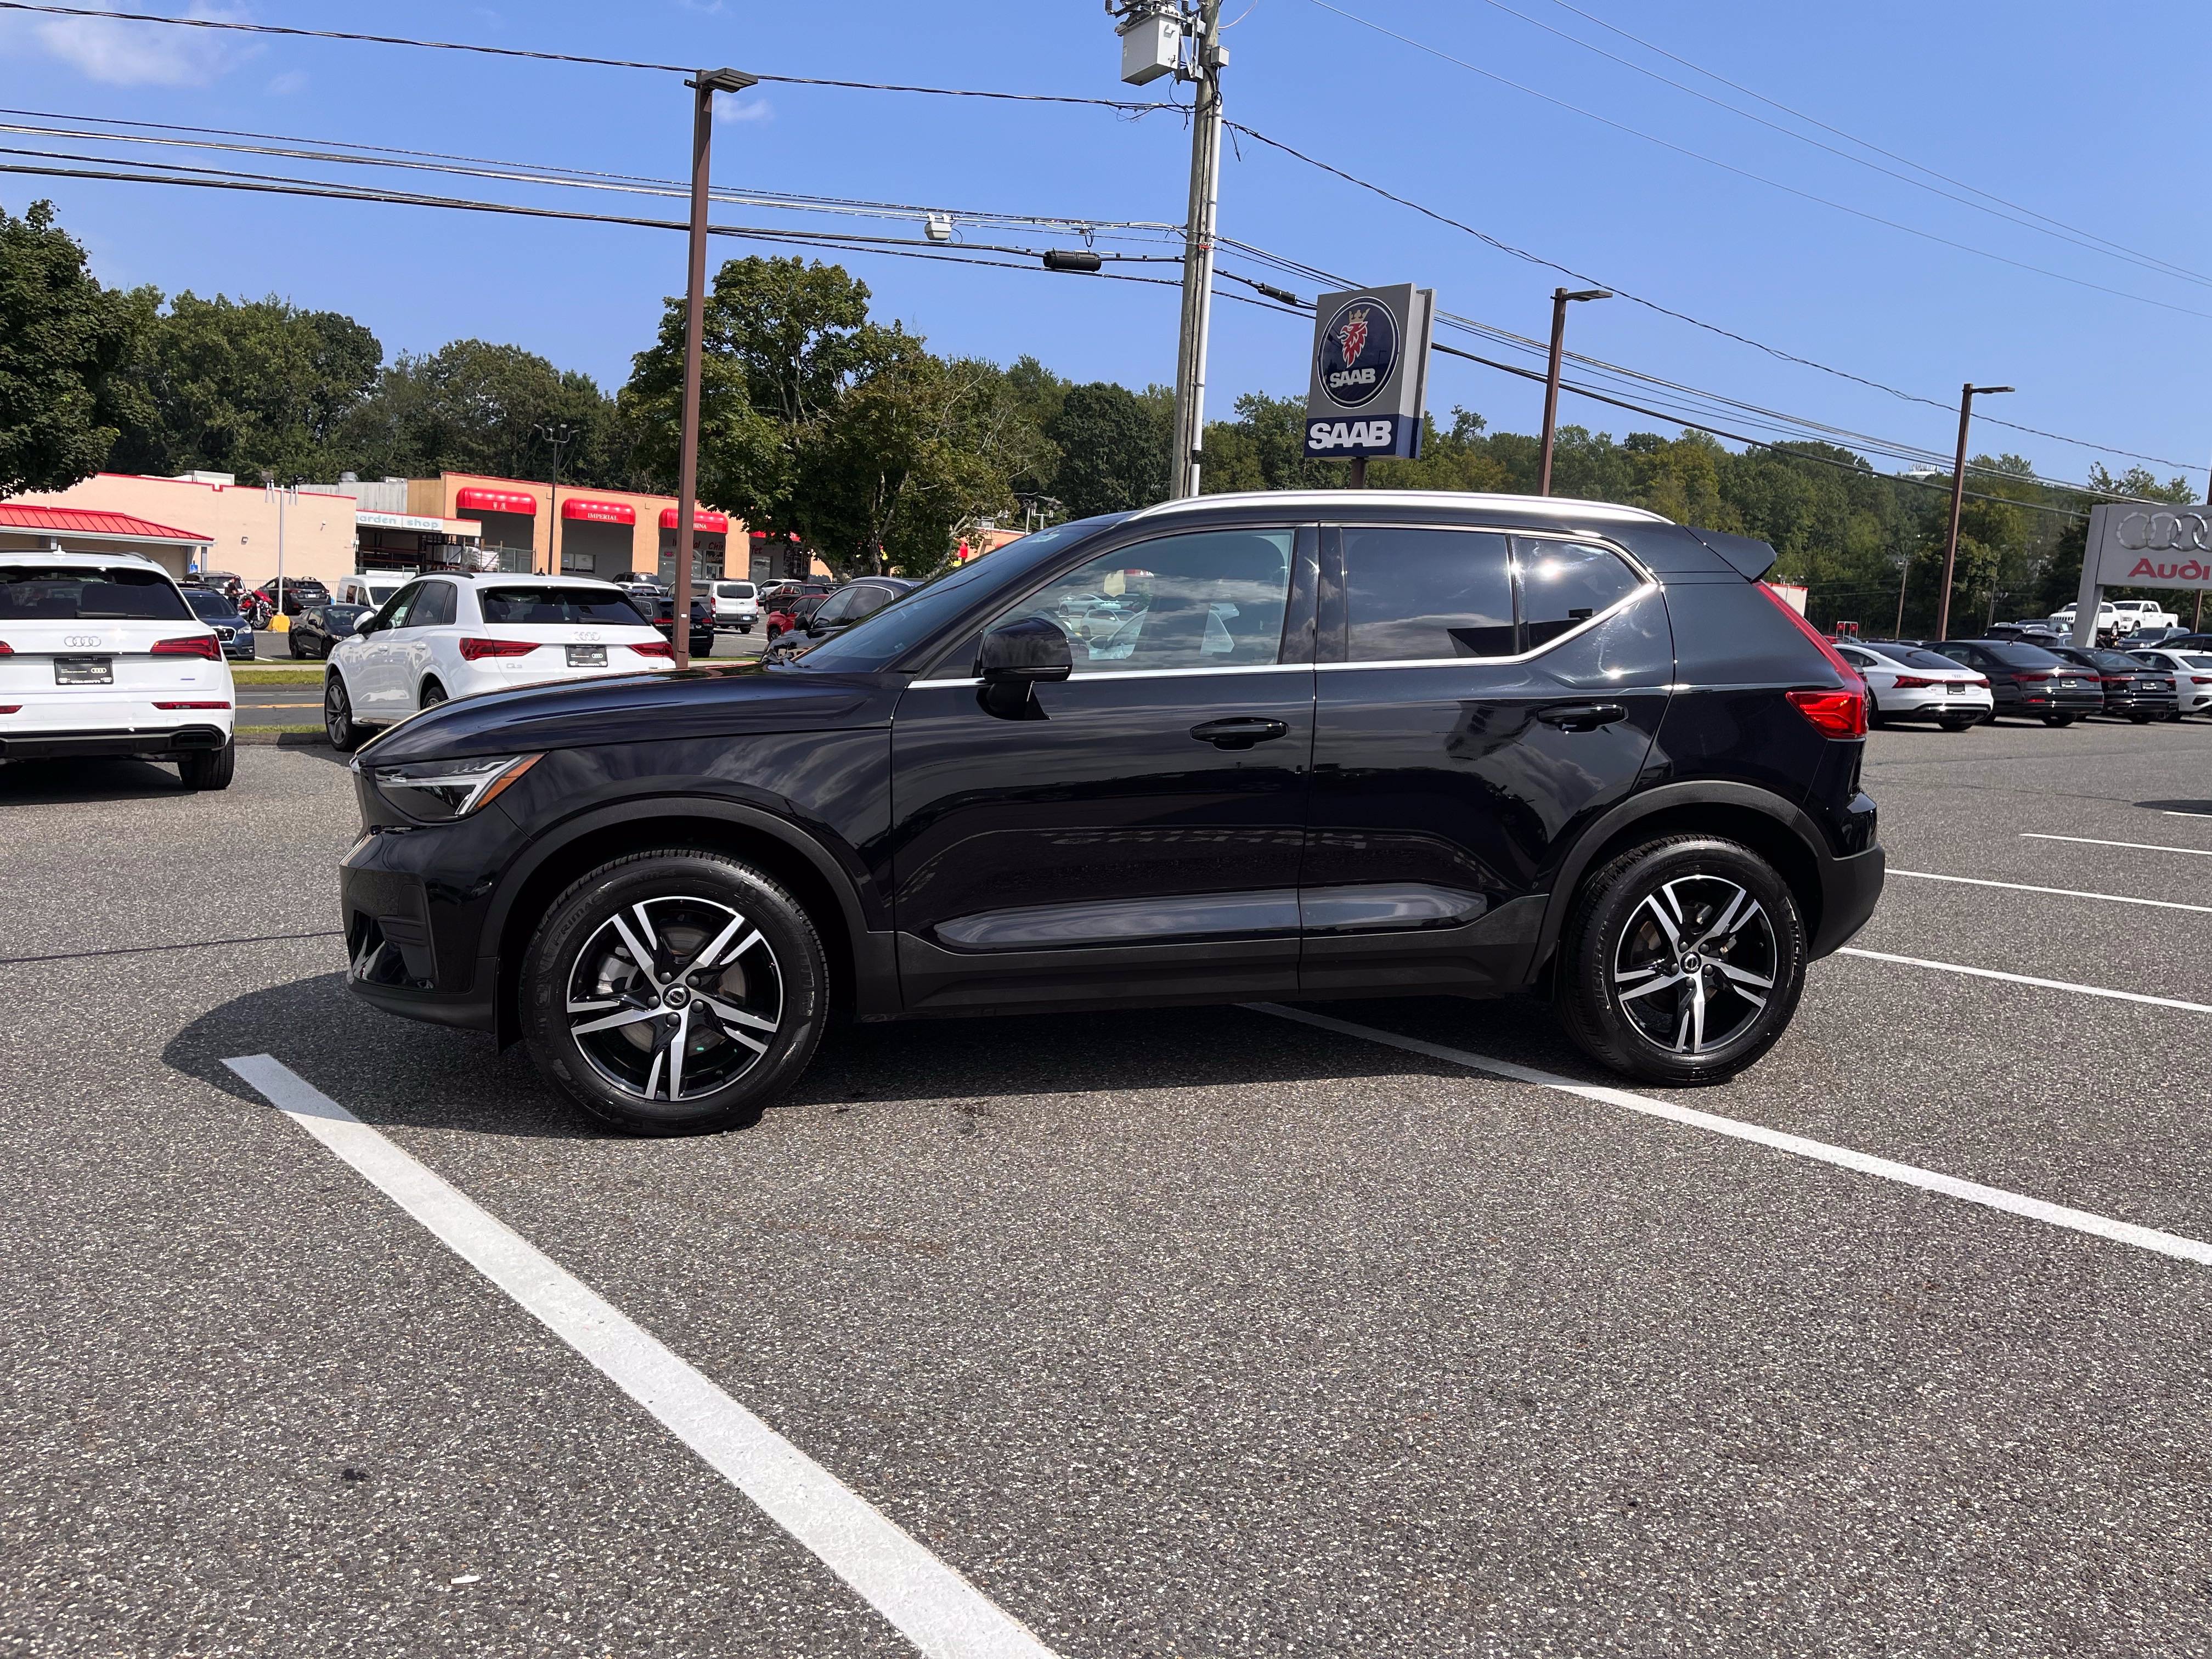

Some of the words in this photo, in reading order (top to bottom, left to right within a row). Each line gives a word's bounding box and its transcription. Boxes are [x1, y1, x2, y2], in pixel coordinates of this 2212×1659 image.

[1330, 368, 1376, 388] SAAB
[1308, 420, 1392, 450] SAAB
[356, 515, 396, 524] arden
[407, 518, 438, 529] shop
[588, 512, 617, 521] IMPERIAL
[2128, 557, 2210, 580] Audi
